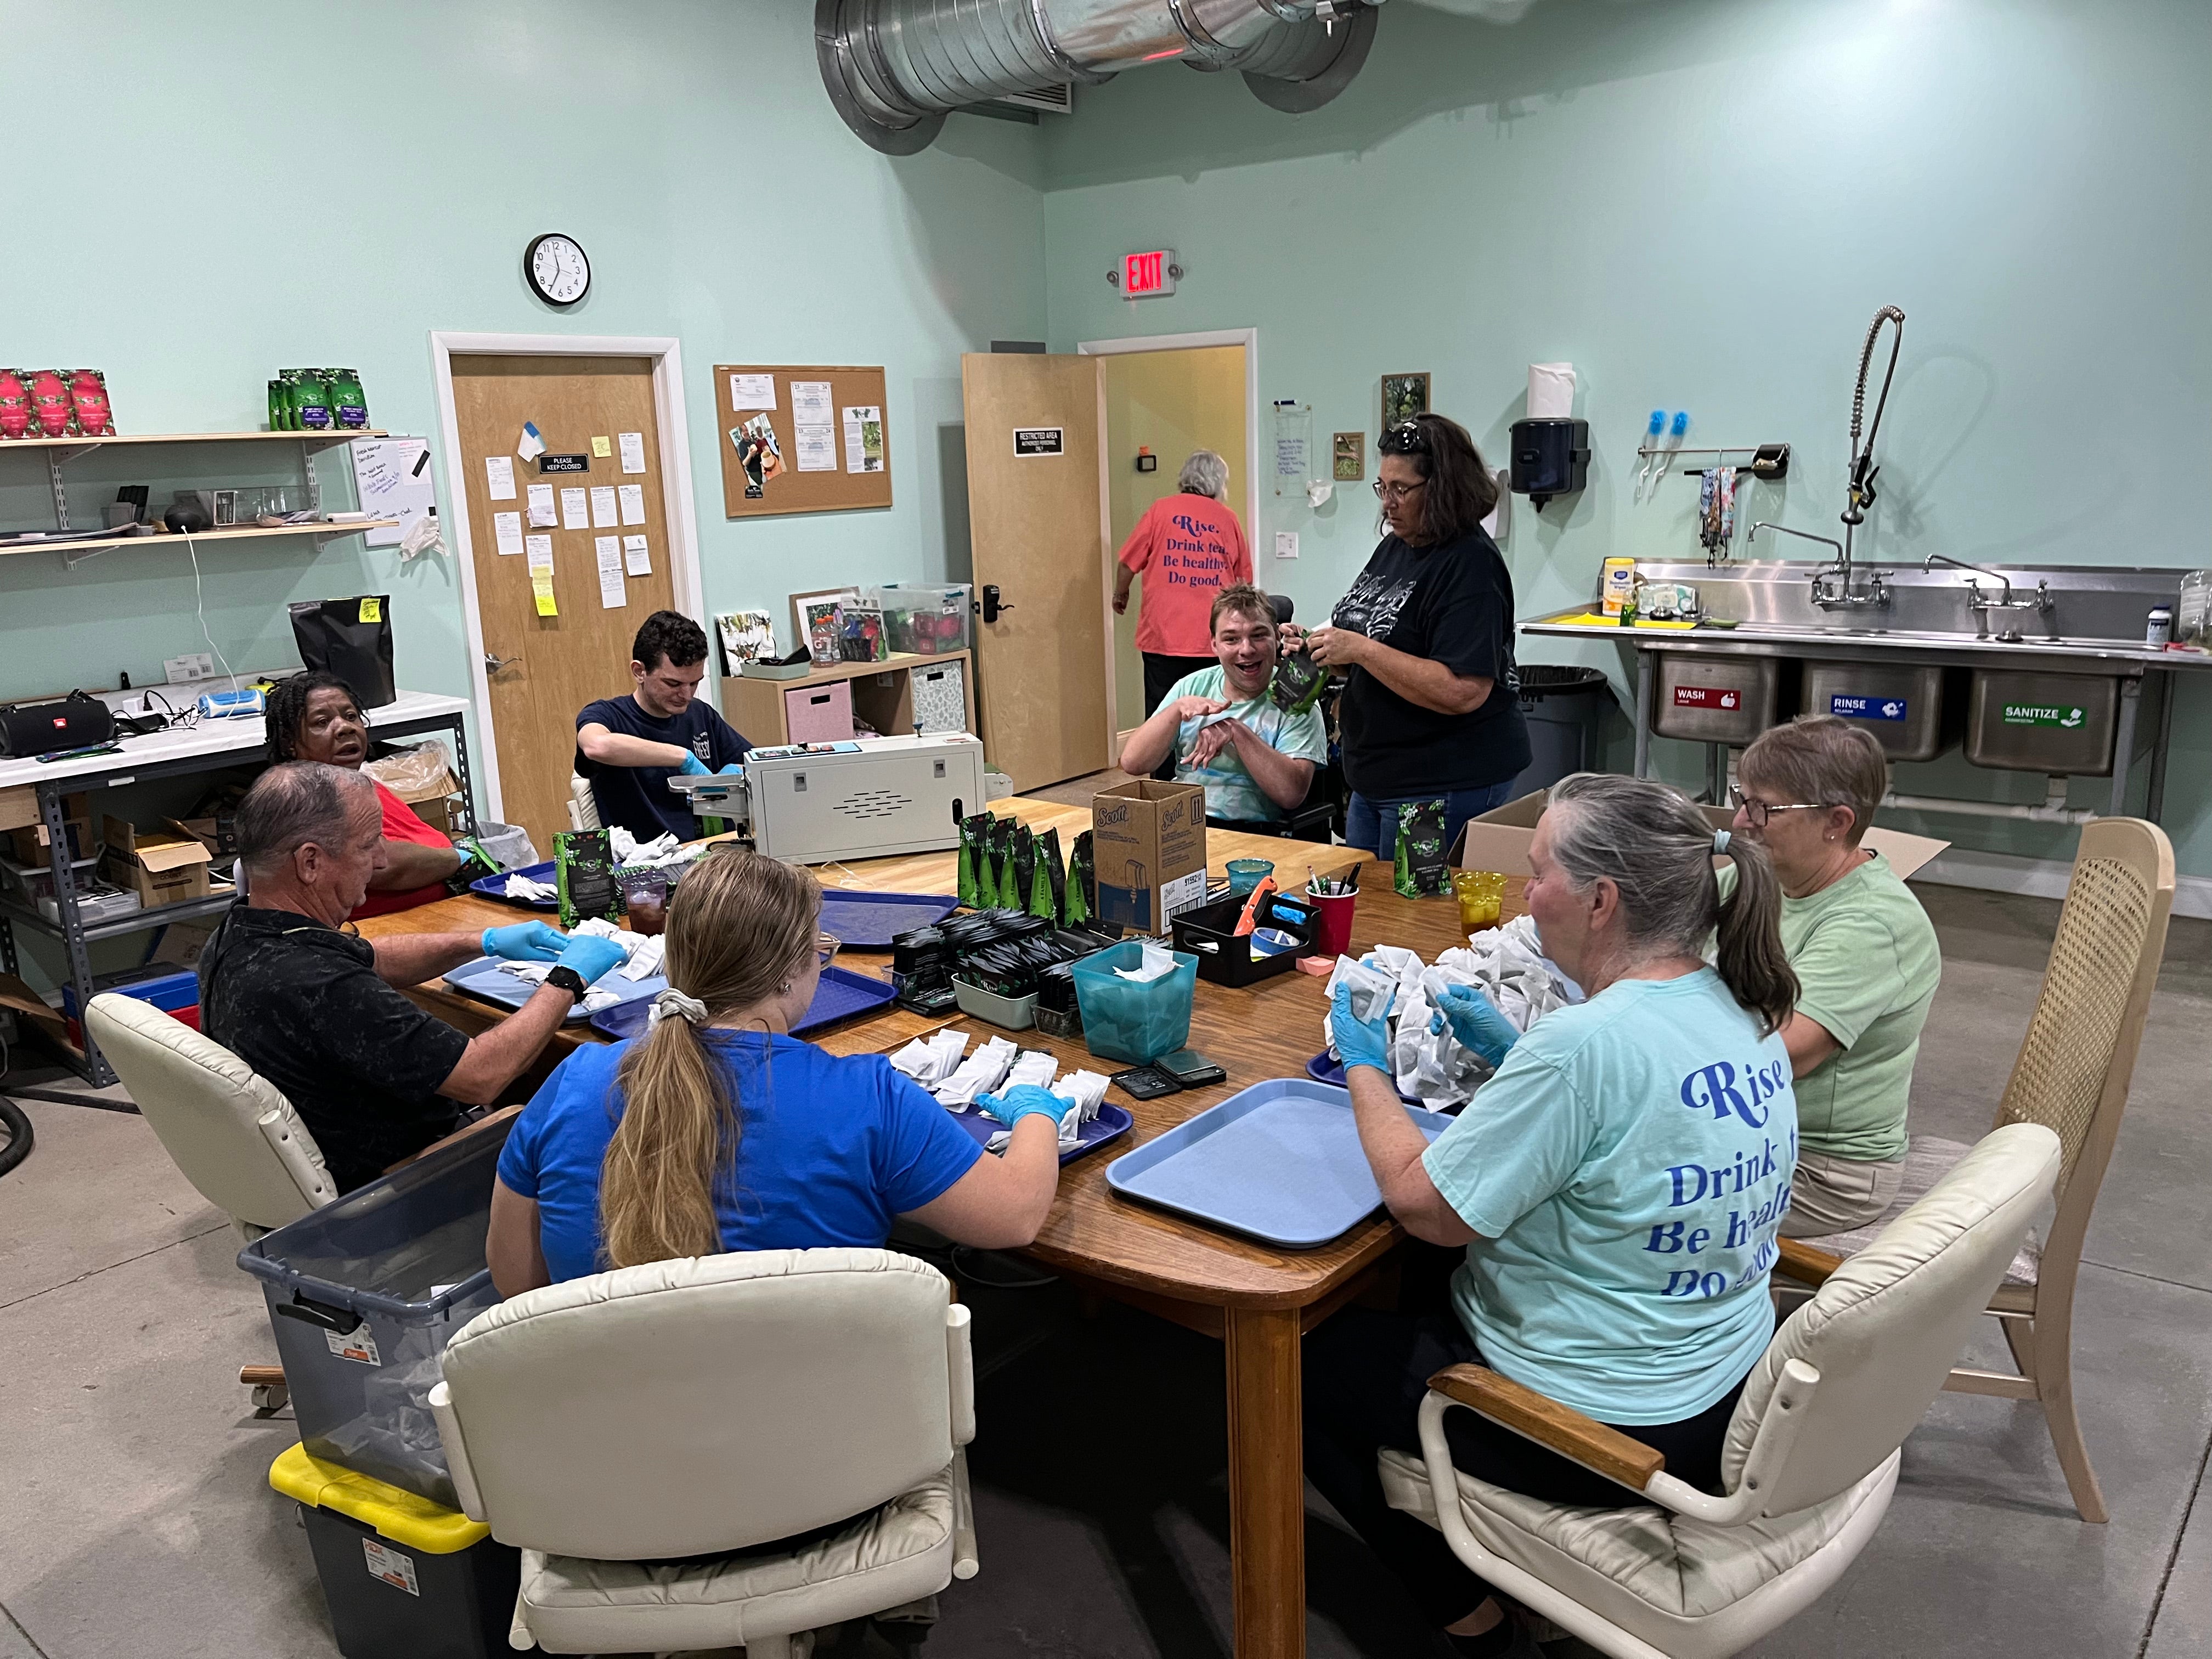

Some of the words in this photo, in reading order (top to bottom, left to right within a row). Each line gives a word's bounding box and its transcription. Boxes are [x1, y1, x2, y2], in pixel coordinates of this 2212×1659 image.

[543, 244, 550, 253] 11
[564, 245, 567, 253] 1
[536, 252, 543, 261] 10
[571, 254, 577, 263] 2
[535, 263, 540, 272] 9
[575, 266, 580, 274] 3
[1126, 251, 1163, 292] EXIT
[540, 276, 545, 285] 8
[573, 278, 578, 286] 4
[558, 288, 563, 297] 6
[567, 286, 572, 295] 5
[1172, 515, 1219, 538] Rise.
[1167, 539, 1204, 552] Drink
[1209, 542, 1228, 555] tea.
[1164, 555, 1178, 566] Be
[1183, 555, 1228, 572] healthy.
[1169, 571, 1186, 583] Do
[1189, 574, 1222, 588] good.
[1678, 689, 1705, 700] WASH
[1834, 698, 1866, 709] RINSE
[2006, 706, 2059, 719] SANITIZE
[1097, 804, 1127, 827] Scott
[1161, 799, 1183, 832] Scott
[1680, 1060, 1785, 1129] Rise
[1664, 1137, 1778, 1207] Drink
[1642, 1221, 1710, 1254] Be
